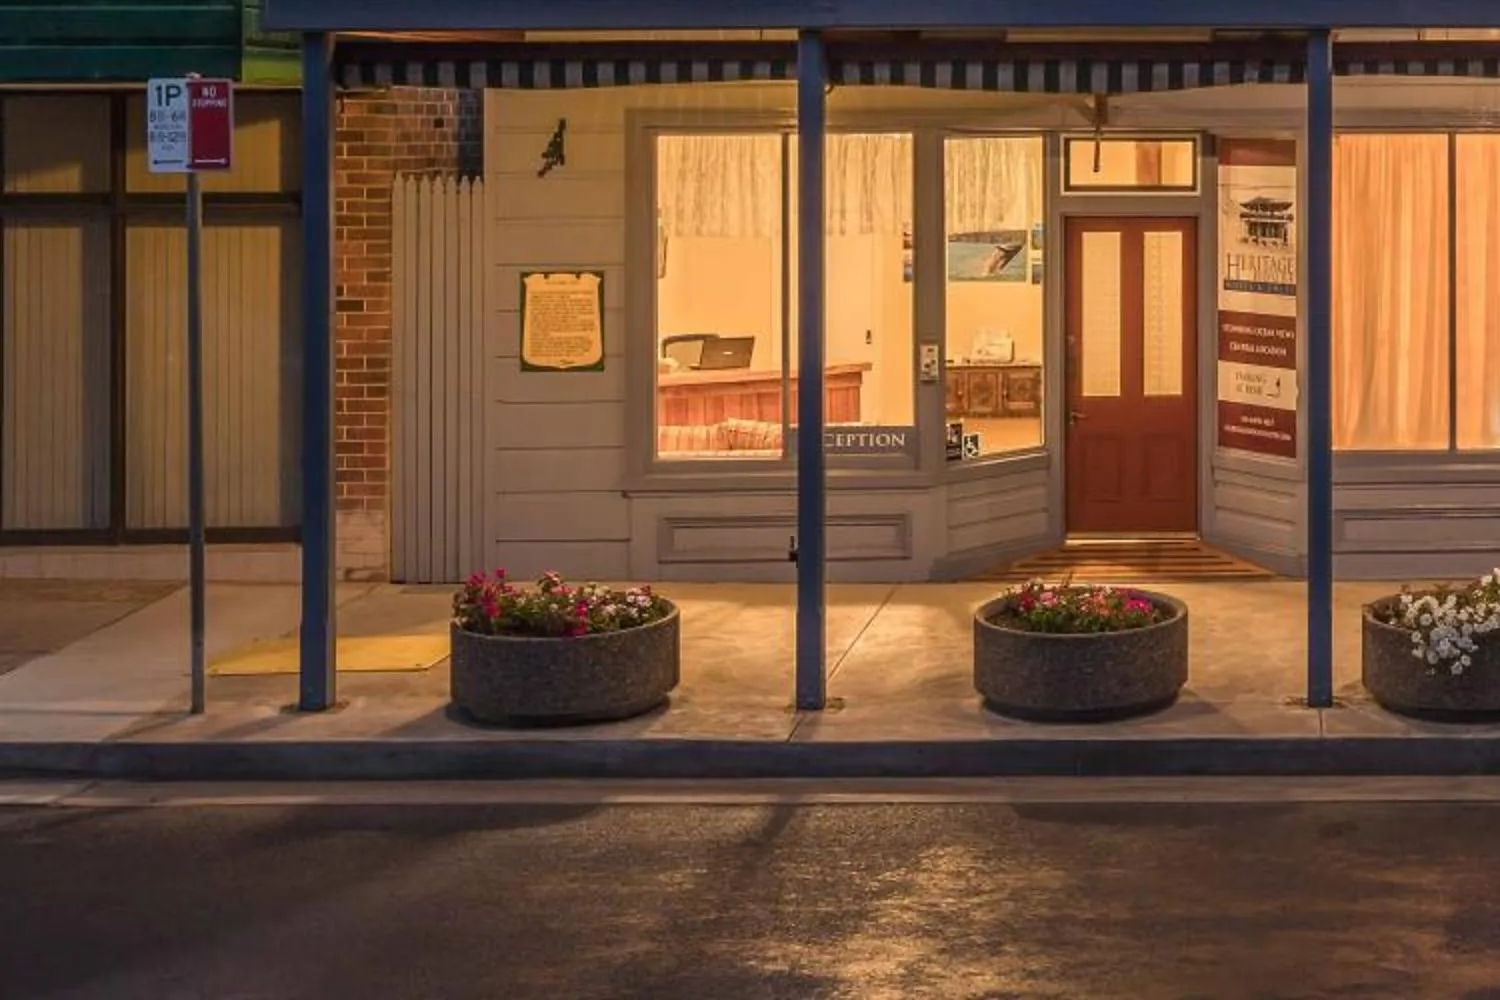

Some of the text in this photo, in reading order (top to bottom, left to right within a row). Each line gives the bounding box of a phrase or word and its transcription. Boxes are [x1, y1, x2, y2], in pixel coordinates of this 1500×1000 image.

[155, 84, 181, 106] 1P
[202, 86, 217, 97] NO
[1227, 252, 1296, 280] HERITAGE
[823, 433, 905, 447] CEPTION
